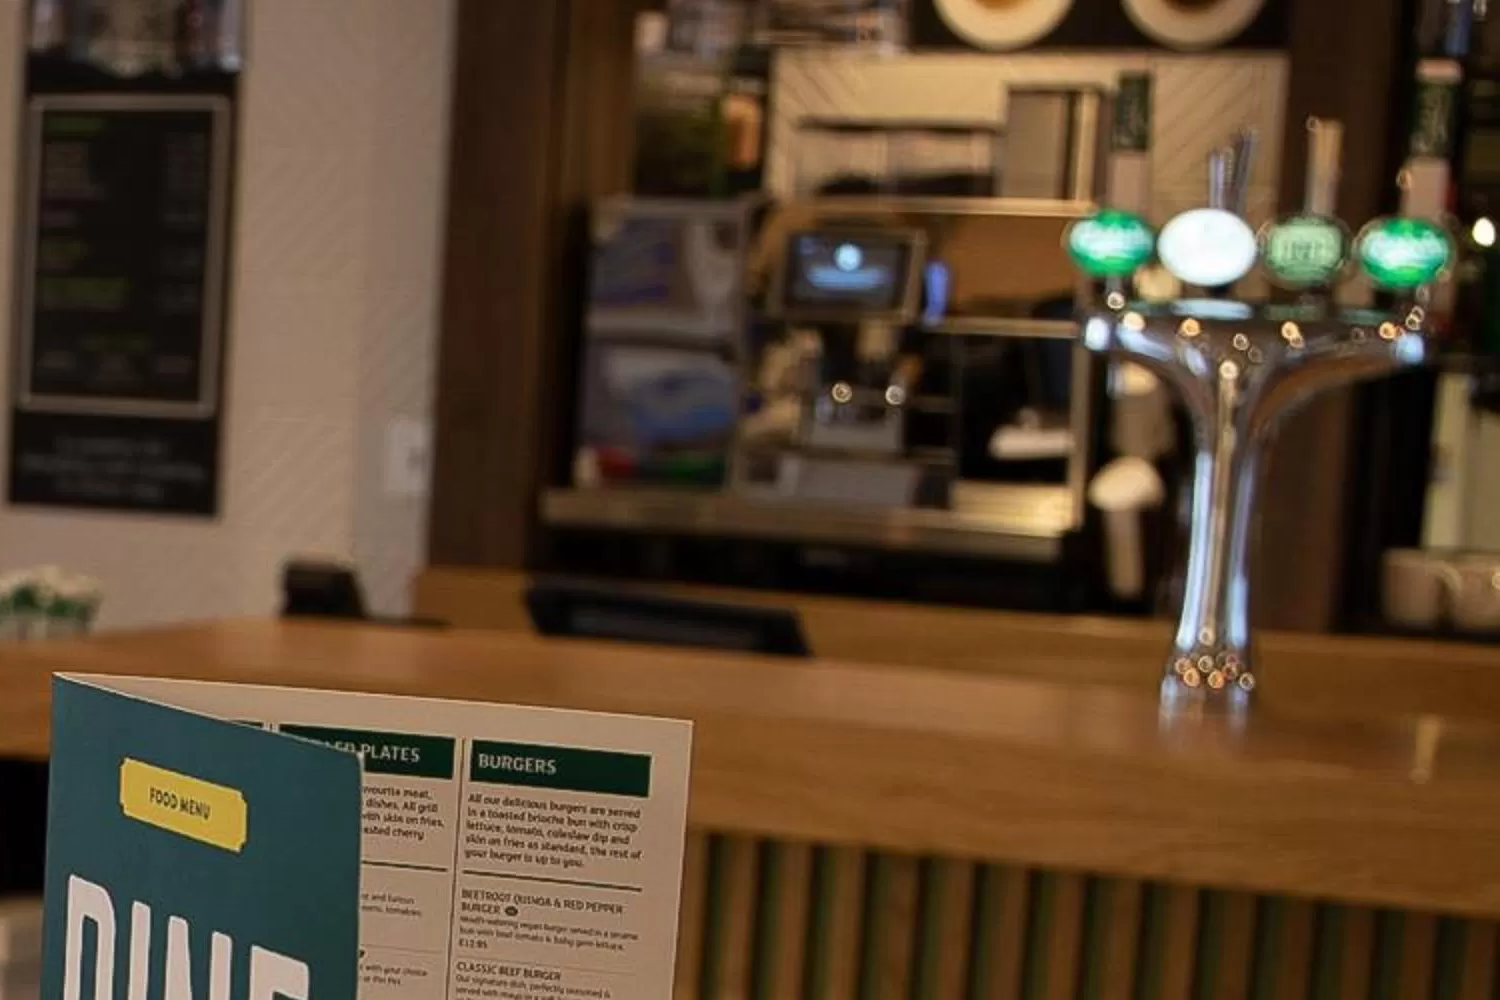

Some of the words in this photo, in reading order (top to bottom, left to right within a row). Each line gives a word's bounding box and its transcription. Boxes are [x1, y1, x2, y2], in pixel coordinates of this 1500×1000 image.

[361, 743, 420, 762] PLATES
[477, 752, 557, 776] BURGERS
[363, 785, 400, 795] vourite
[149, 787, 178, 809] FOOD
[180, 797, 211, 820] MENU
[402, 801, 416, 810] All
[418, 802, 437, 815] grill
[467, 794, 481, 803] All
[483, 797, 499, 805] our
[501, 797, 546, 809] delicious
[549, 801, 586, 816] burgers
[589, 807, 605, 815] are
[607, 806, 640, 818] served
[383, 813, 403, 823] skin
[487, 808, 525, 821] toasted
[527, 812, 563, 825] brioche
[566, 816, 586, 827] bun
[588, 818, 609, 829] with
[612, 820, 638, 834] crisp
[363, 824, 390, 835] asted
[391, 826, 424, 841] cherry
[546, 828, 589, 841] coleslaw
[592, 832, 608, 845] dip
[610, 834, 630, 845] and
[465, 833, 485, 844] skin
[503, 837, 524, 848] fries
[590, 845, 606, 855] the
[609, 847, 627, 857] rest
[463, 848, 486, 859] your
[489, 849, 521, 863] burger
[460, 888, 511, 903] BEETROOT
[513, 893, 553, 908] QUINOA
[563, 898, 582, 910] RED
[585, 900, 622, 914] PEPPER
[460, 901, 500, 915] BURGER
[455, 961, 497, 974] CLASSIC
[498, 965, 521, 977] BEEF
[523, 968, 561, 981] BURGER
